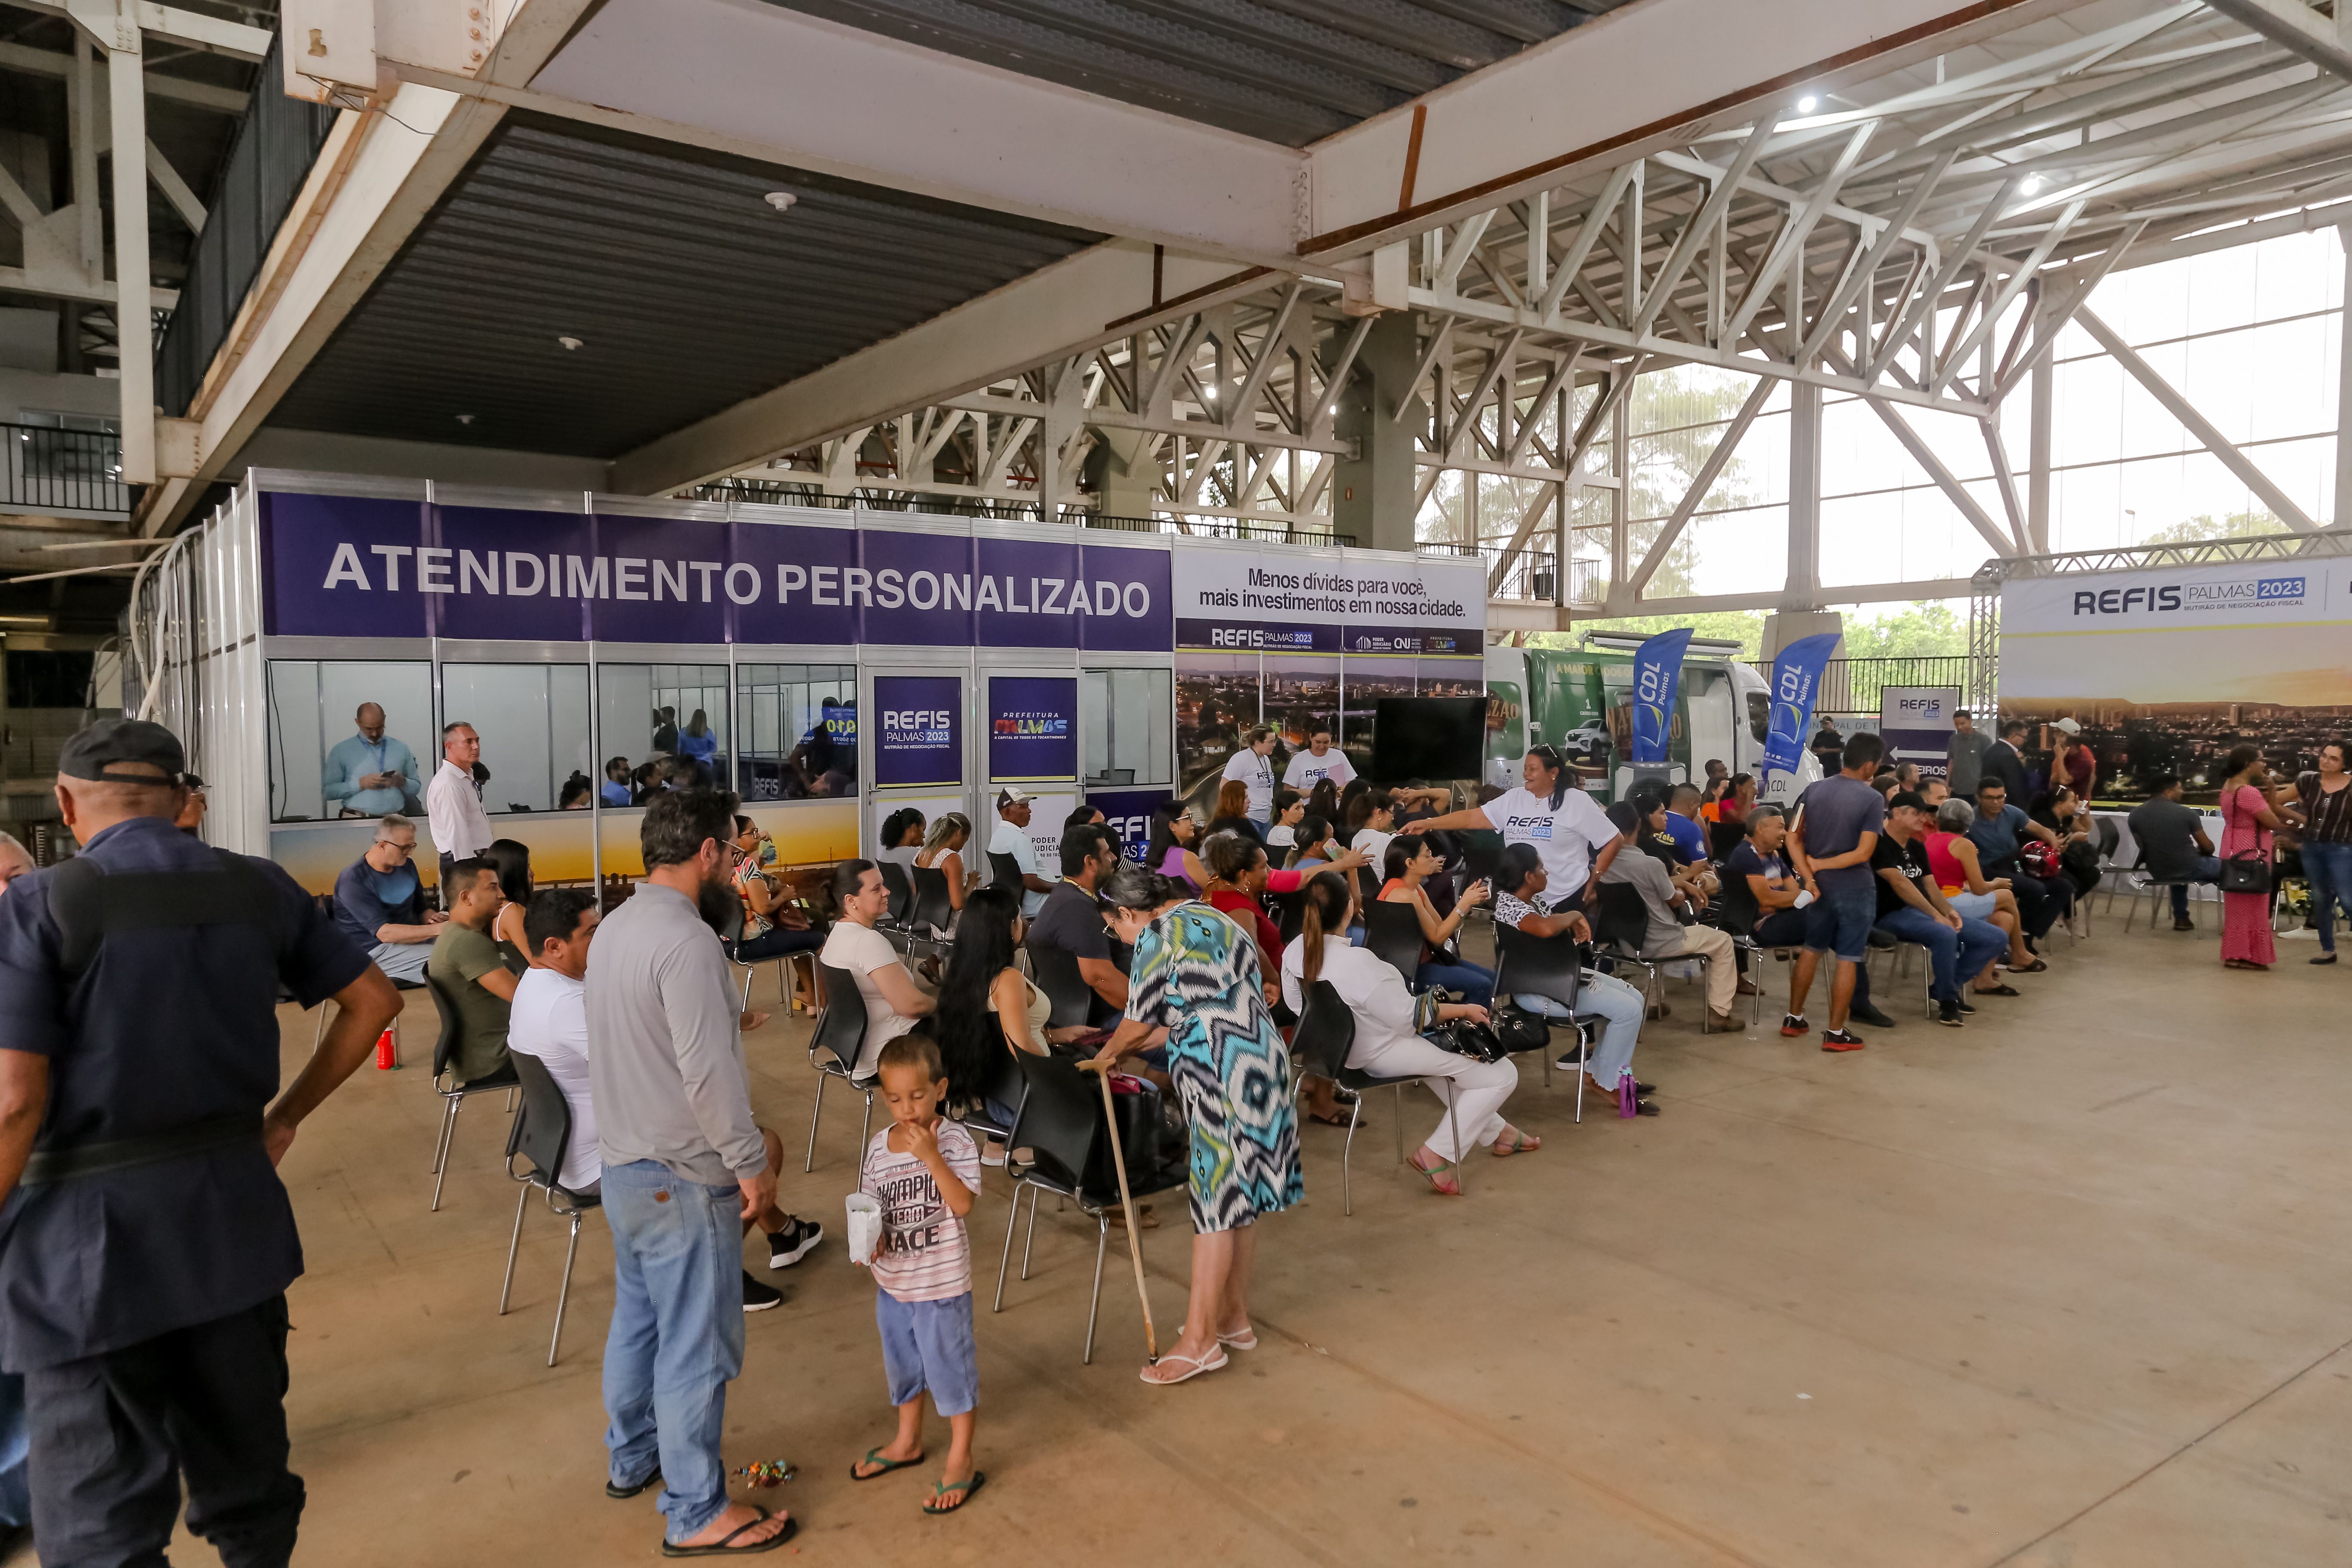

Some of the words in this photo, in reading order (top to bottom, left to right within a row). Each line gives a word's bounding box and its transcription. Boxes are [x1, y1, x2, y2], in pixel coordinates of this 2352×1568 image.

[323, 543, 761, 605] ATENDIMENTO
[778, 564, 1150, 618] PERSONALIZADO
[1249, 568, 1299, 589] Menos
[1303, 572, 1354, 593] dívidas
[1358, 580, 1388, 597] para
[1392, 578, 1427, 598] você,
[1200, 588, 1238, 607] mais
[1243, 589, 1346, 613] investimentos
[1349, 600, 1372, 613] em
[1375, 600, 1418, 615] nossa
[1419, 599, 1466, 617] cidade.
[2074, 585, 2181, 615] REFIS
[2189, 584, 2255, 600] PALMAS
[2260, 580, 2303, 597] 2023
[1212, 628, 1264, 647] REFIS
[1265, 632, 1293, 642] PALMAS
[1295, 634, 1312, 643] 2023
[1638, 662, 1661, 702] CDL
[1658, 671, 1670, 706] Palmas
[1780, 665, 1802, 702] CDL
[1798, 674, 1812, 706] Palmas
[1900, 699, 1940, 710] REFIS
[884, 710, 950, 729] REFIS
[994, 720, 1068, 734] PALMAS
[887, 732, 925, 742] PALMAS
[927, 732, 949, 741] 2023
[754, 778, 778, 795] REFIS
[1771, 780, 1786, 791] CDL
[1107, 815, 1151, 842] EFI
[1506, 816, 1554, 827] REFIS
[1035, 843, 1060, 851] UDICIÁ
[891, 1205, 924, 1225] TEAM
